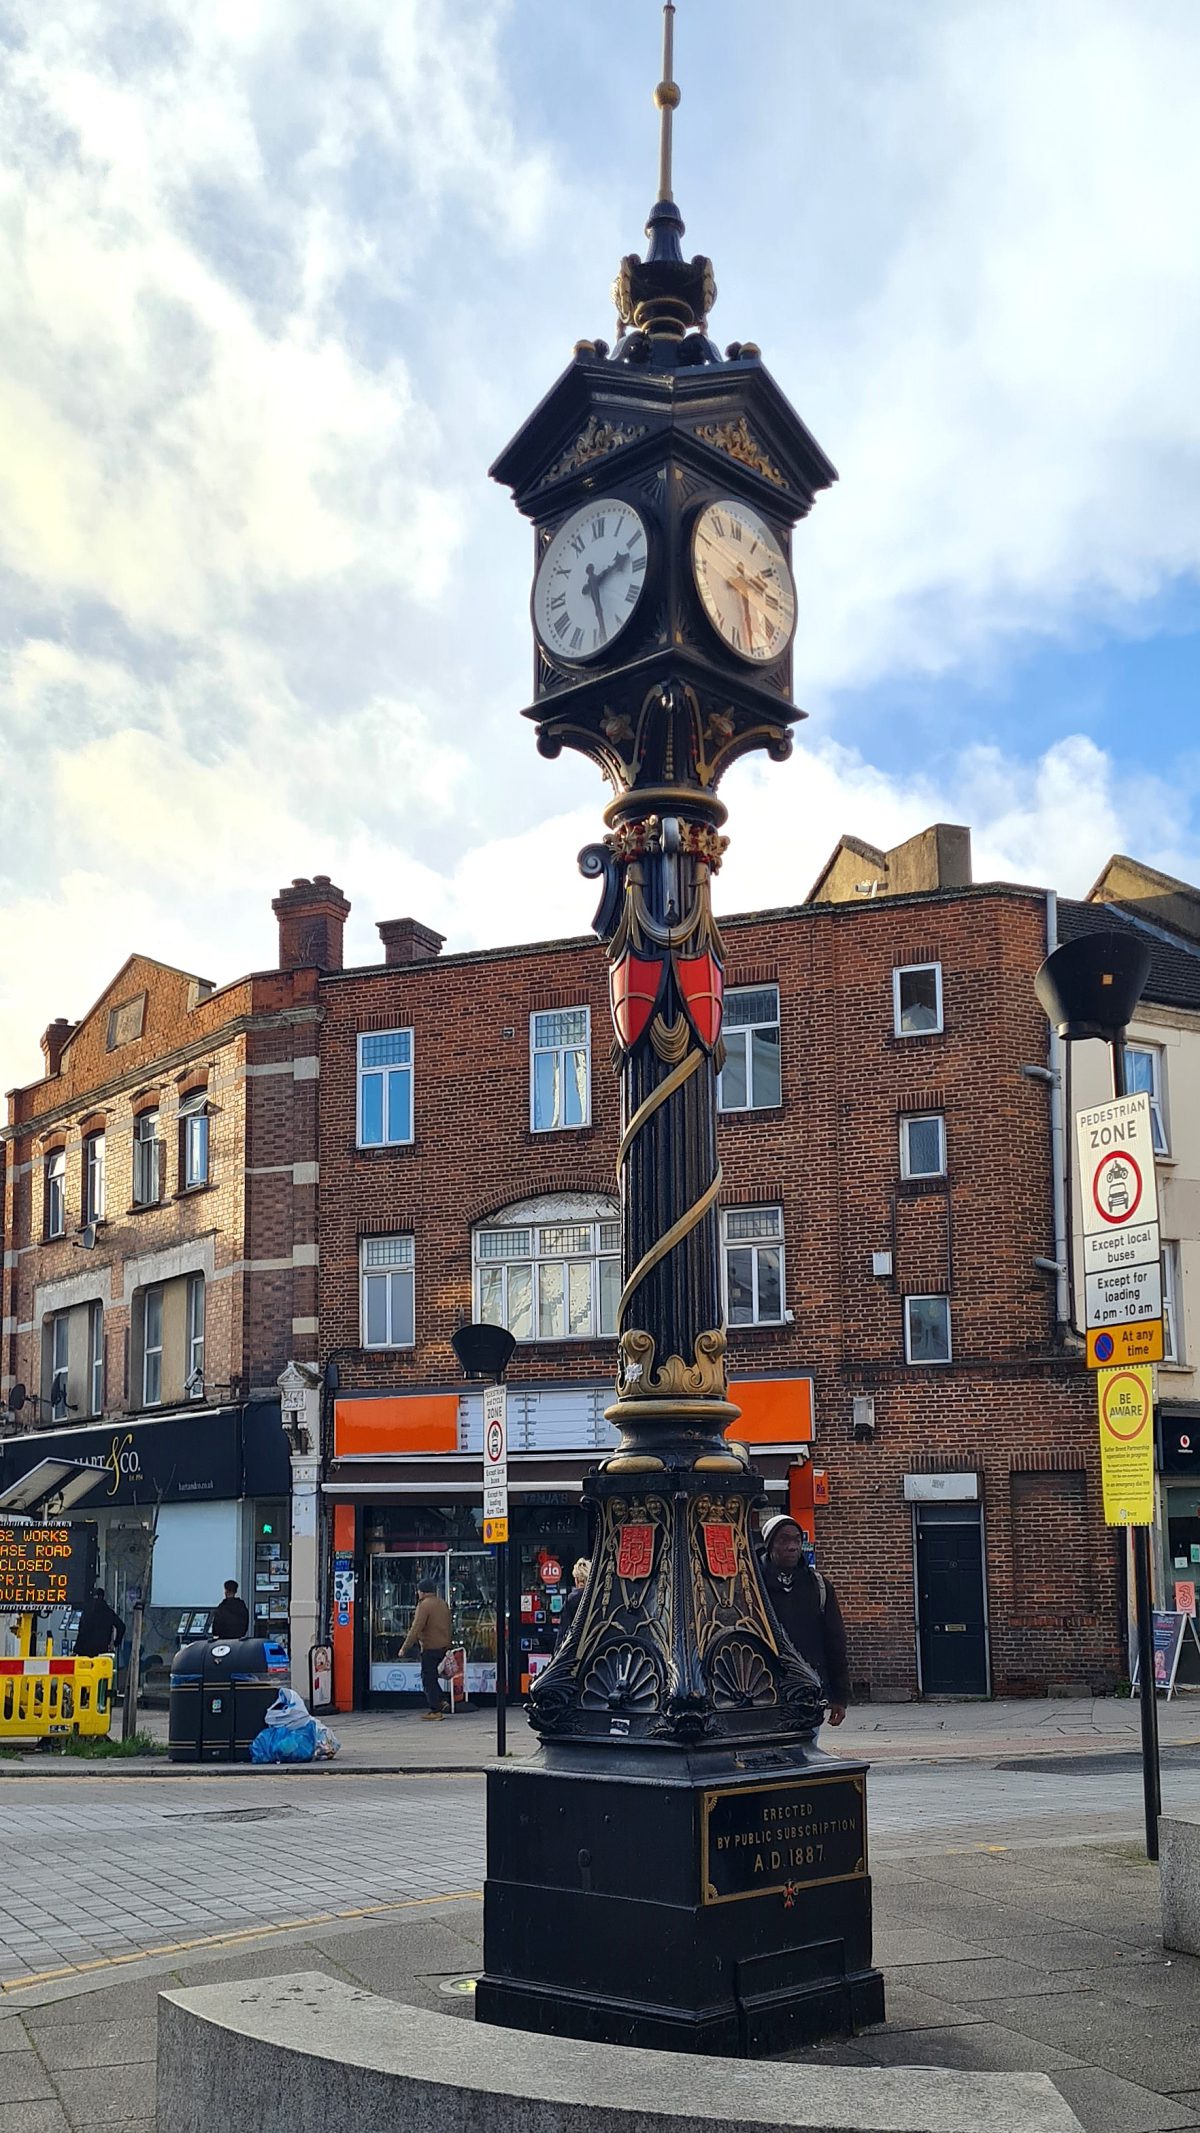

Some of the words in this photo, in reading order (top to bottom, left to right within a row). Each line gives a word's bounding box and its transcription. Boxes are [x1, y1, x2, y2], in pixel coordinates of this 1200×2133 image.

[1080, 1099, 1146, 1127] PEDESTRIAN
[1090, 1120, 1137, 1148] ZONE
[1092, 1235, 1125, 1252] Except
[1127, 1230, 1151, 1245] local
[1107, 1249, 1135, 1263] buses
[1097, 1273, 1131, 1289] Except
[1133, 1272, 1148, 1284] for
[1105, 1288, 1140, 1303] loading
[1122, 1331, 1133, 1342] At
[1136, 1329, 1154, 1341] any
[1127, 1344, 1149, 1356] time
[1119, 1393, 1132, 1405] BE
[487, 1405, 502, 1419] ZONE
[1109, 1404, 1143, 1418] AWARE
[120, 1451, 141, 1473] CO.
[23, 1530, 69, 1542] WORKS
[36, 1544, 72, 1557] ROAD
[0, 1559, 53, 1572] CLOSED
[48, 1574, 67, 1587] TO
[763, 1803, 813, 1821] ERECTED
[717, 1836, 731, 1849] BY
[735, 1831, 772, 1846] PUBLIC
[777, 1818, 856, 1841] SUBSCRIPTION
